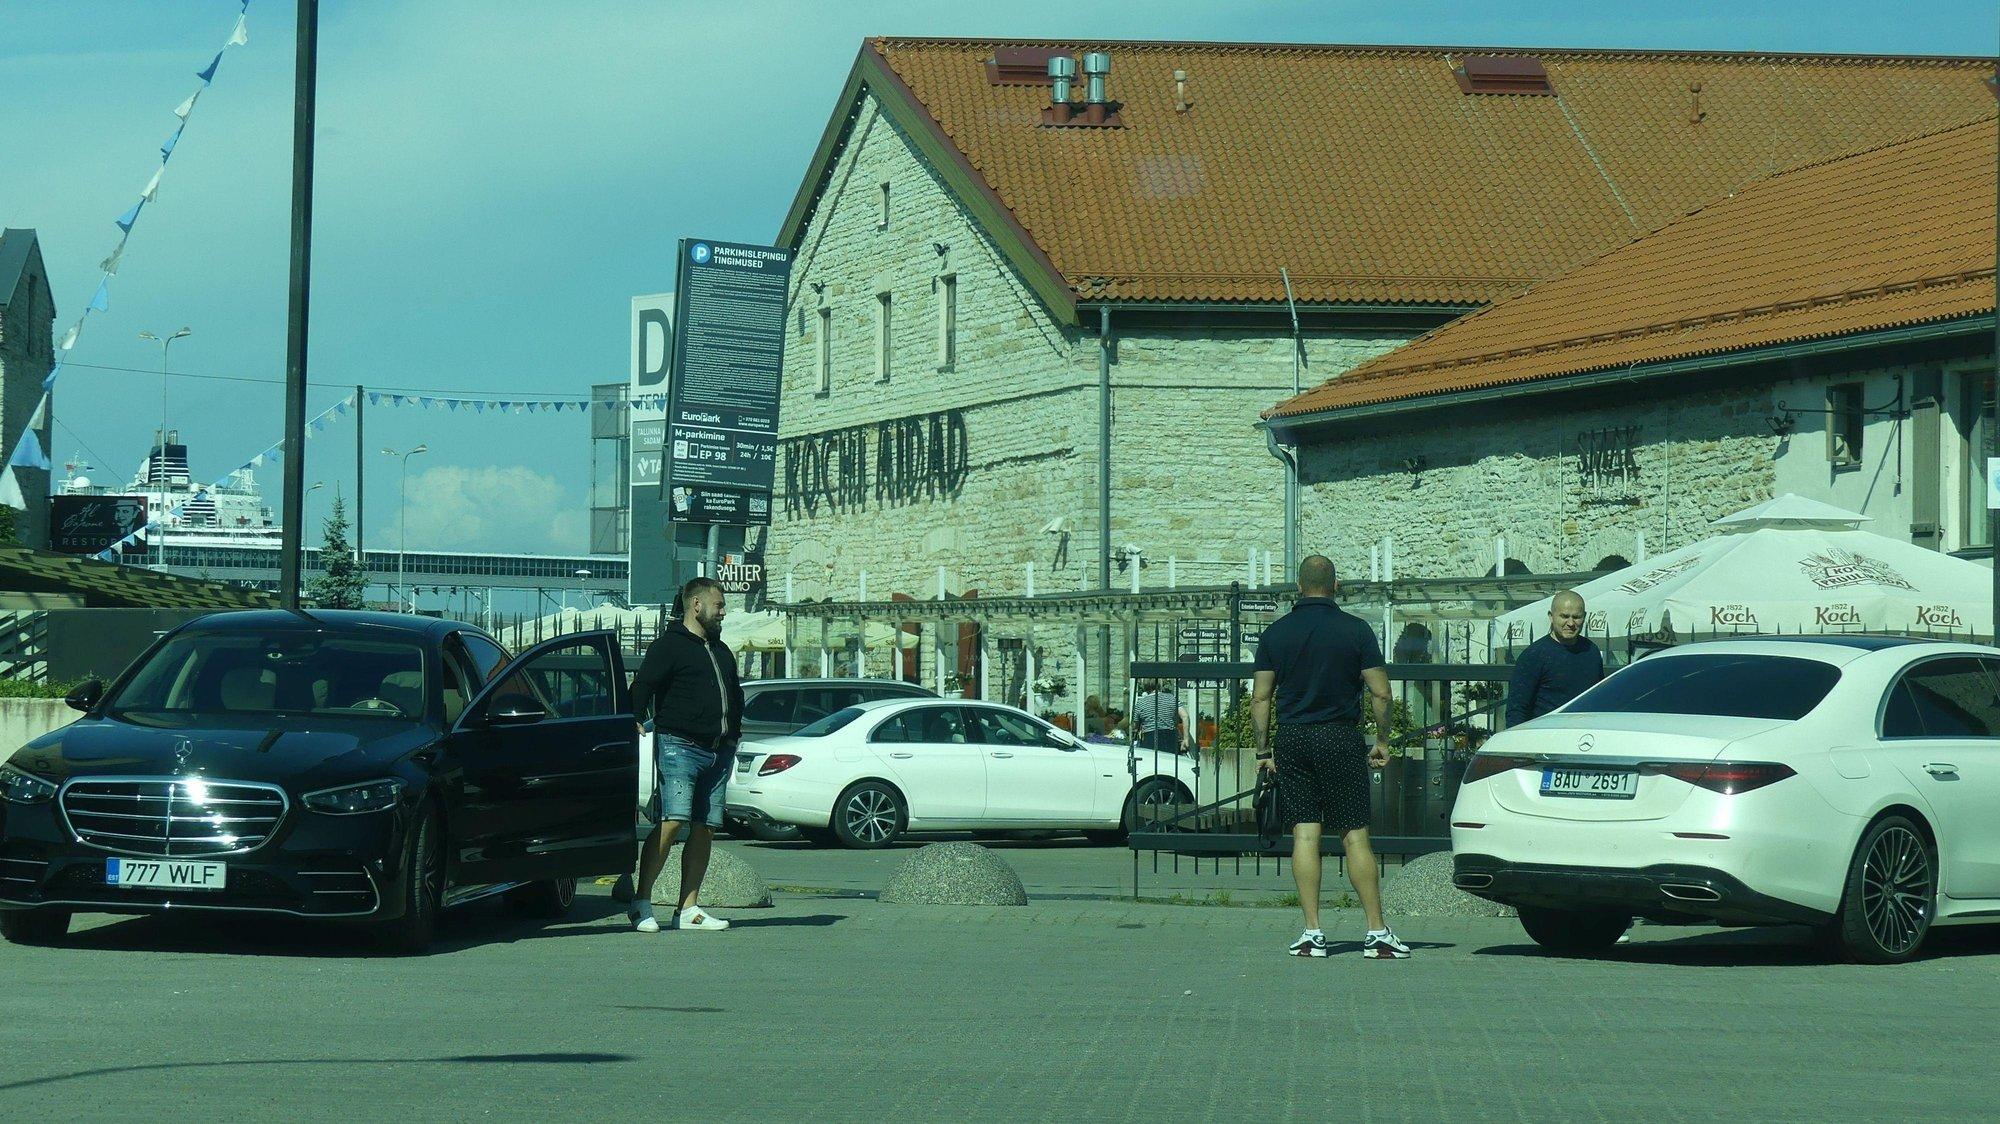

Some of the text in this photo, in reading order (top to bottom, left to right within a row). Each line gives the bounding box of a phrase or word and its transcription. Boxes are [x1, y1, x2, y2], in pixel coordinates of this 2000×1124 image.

[696, 247, 707, 260] P
[714, 246, 787, 262] PARKIMISLEPINGU
[713, 255, 763, 269] TINGIMUSED
[639, 308, 671, 386] D
[682, 411, 720, 424] EuroPark
[674, 428, 726, 442] M-parkimine
[736, 442, 755, 450] 30min
[700, 450, 727, 461] EP 98
[784, 409, 968, 516] KOCHI AIDAD
[719, 581, 750, 591] ANIMO
[1710, 606, 1758, 625] Koch
[1814, 605, 1861, 625] Koch
[1915, 605, 1963, 626] Koch
[1554, 772, 1629, 791] 8AU 2691
[126, 863, 217, 884] 777 WLF
